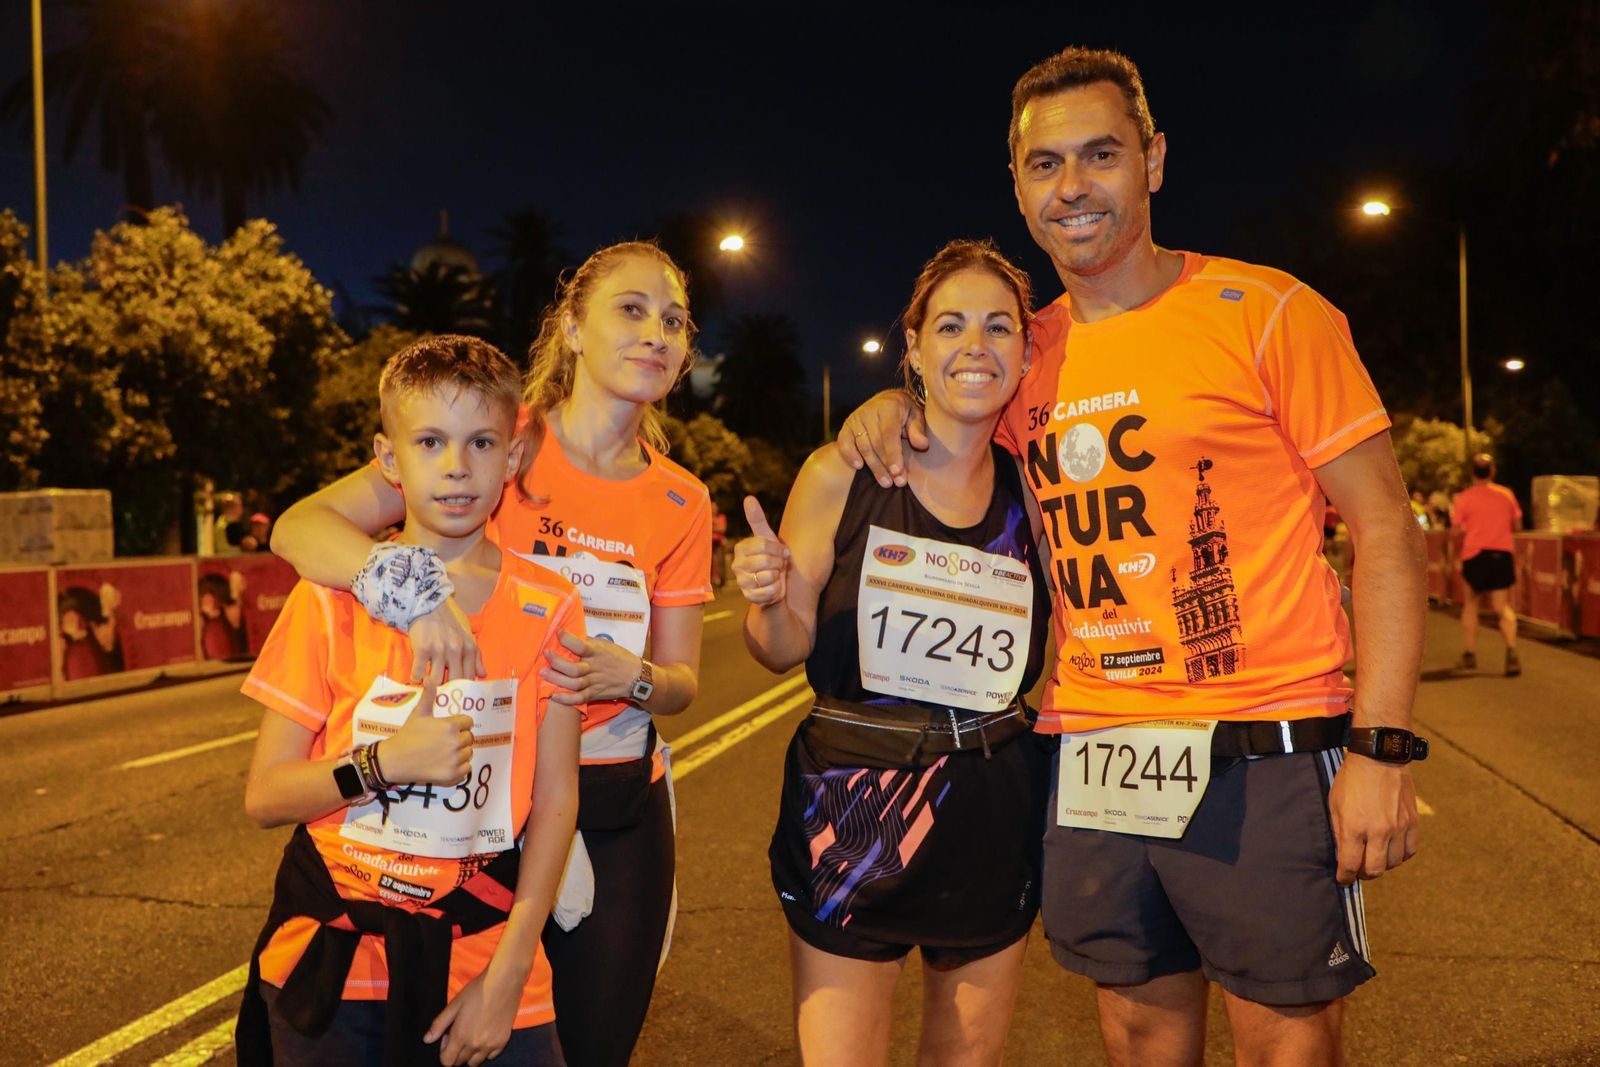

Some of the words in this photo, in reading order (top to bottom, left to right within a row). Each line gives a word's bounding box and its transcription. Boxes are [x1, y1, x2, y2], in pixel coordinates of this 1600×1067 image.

[1028, 402, 1050, 431] 36
[1053, 389, 1140, 421] CARRERA
[1040, 484, 1156, 549] TUR
[538, 517, 564, 537] 36
[567, 527, 635, 557] CARRERA
[888, 581, 914, 592] CARRERA
[915, 587, 945, 598] NOCTURNA
[946, 593, 957, 601] DEL
[958, 596, 999, 609] GUADALQUIVIR
[1013, 607, 1026, 615] 2024
[1056, 554, 1128, 610] NA
[1102, 608, 1118, 620] del
[871, 606, 1015, 673] 17243
[1103, 655, 1115, 666] 27
[1116, 651, 1161, 667] septiembre
[1105, 669, 1137, 680] SEVILLA
[1139, 666, 1162, 676] 2024
[1076, 742, 1198, 793] 17244
[1065, 807, 1099, 818] Cruzcampo
[342, 844, 441, 877] Guadalquivir
[398, 853, 414, 862] del
[381, 875, 393, 887] 27
[392, 879, 432, 898] septiembre
[1328, 953, 1350, 966] adidas
